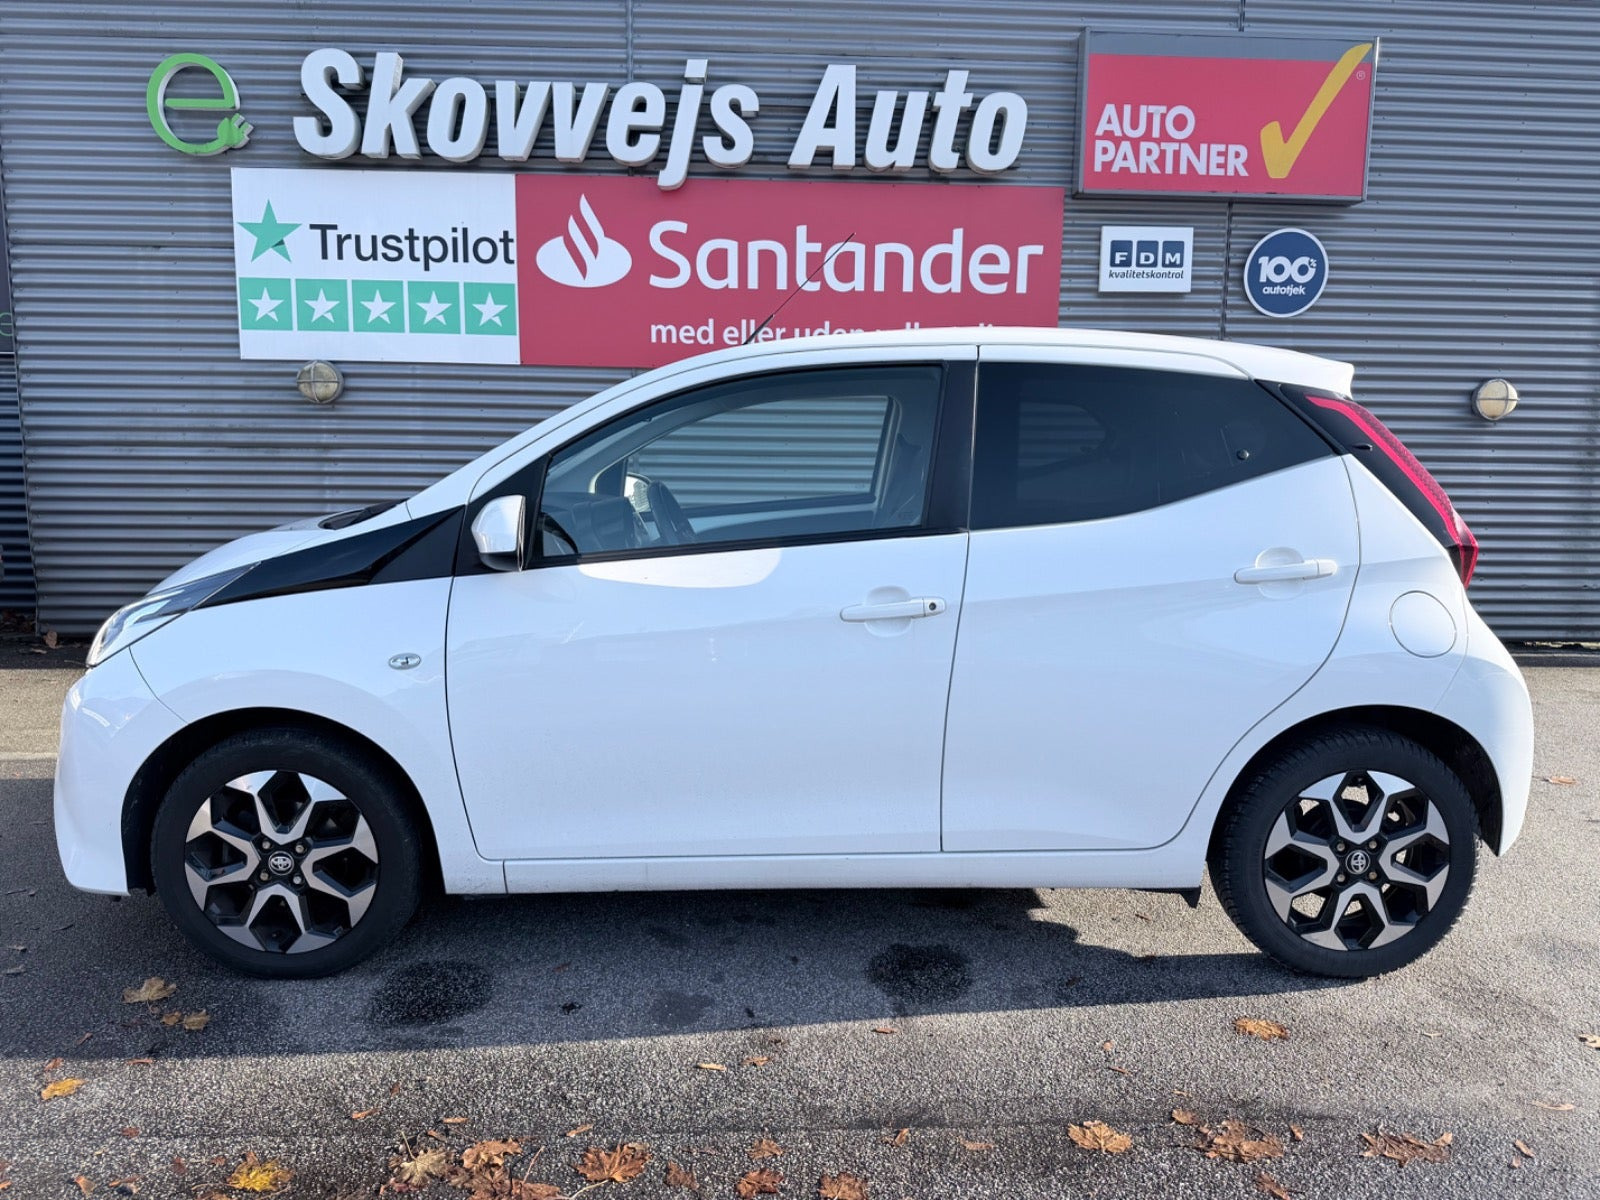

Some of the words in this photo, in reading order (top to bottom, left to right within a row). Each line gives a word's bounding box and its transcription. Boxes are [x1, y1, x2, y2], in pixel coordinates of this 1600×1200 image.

[293, 48, 760, 190] Skovvejs
[787, 64, 1029, 174] Auto
[1095, 103, 1196, 140] AUTO
[1093, 139, 1249, 177] PARTNER
[309, 223, 515, 271] Trustpilot
[648, 220, 1044, 295] Santander
[1113, 250, 1182, 266] FDM
[1108, 269, 1185, 280] kvalitetskontrol
[1262, 284, 1307, 297] autotjek
[650, 318, 715, 344] med
